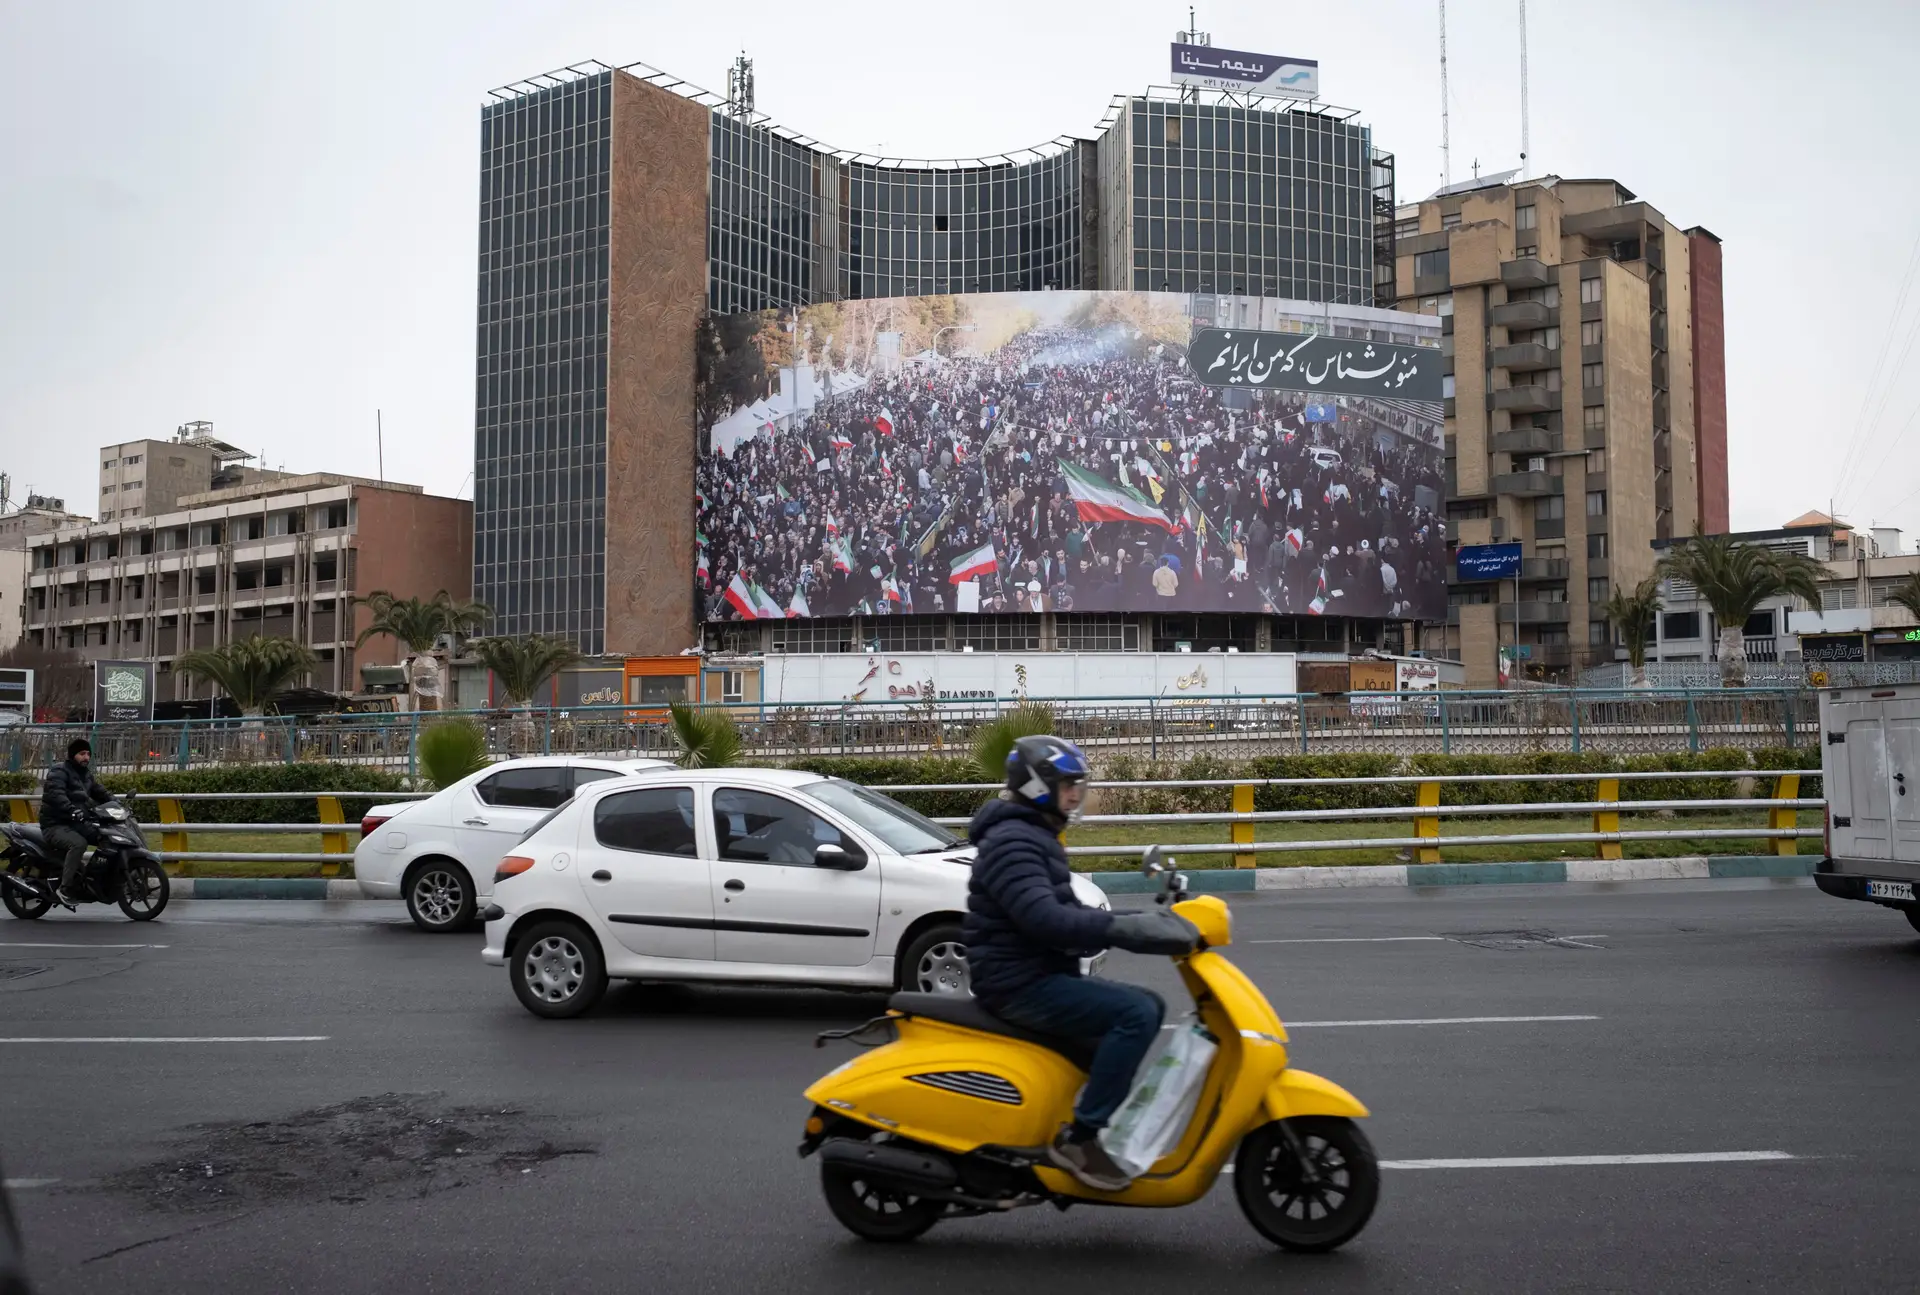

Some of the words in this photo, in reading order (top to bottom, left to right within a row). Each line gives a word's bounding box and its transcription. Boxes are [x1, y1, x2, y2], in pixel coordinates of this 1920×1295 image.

[1180, 51, 1220, 70] سینا
[1221, 59, 1264, 78] بیمه
[1204, 79, 1216, 87] ۰۲۱
[1220, 81, 1242, 90] ۲۸۰۷
[1207, 332, 1259, 384] ایرانم
[1247, 348, 1285, 384] من
[1279, 332, 1318, 373] که
